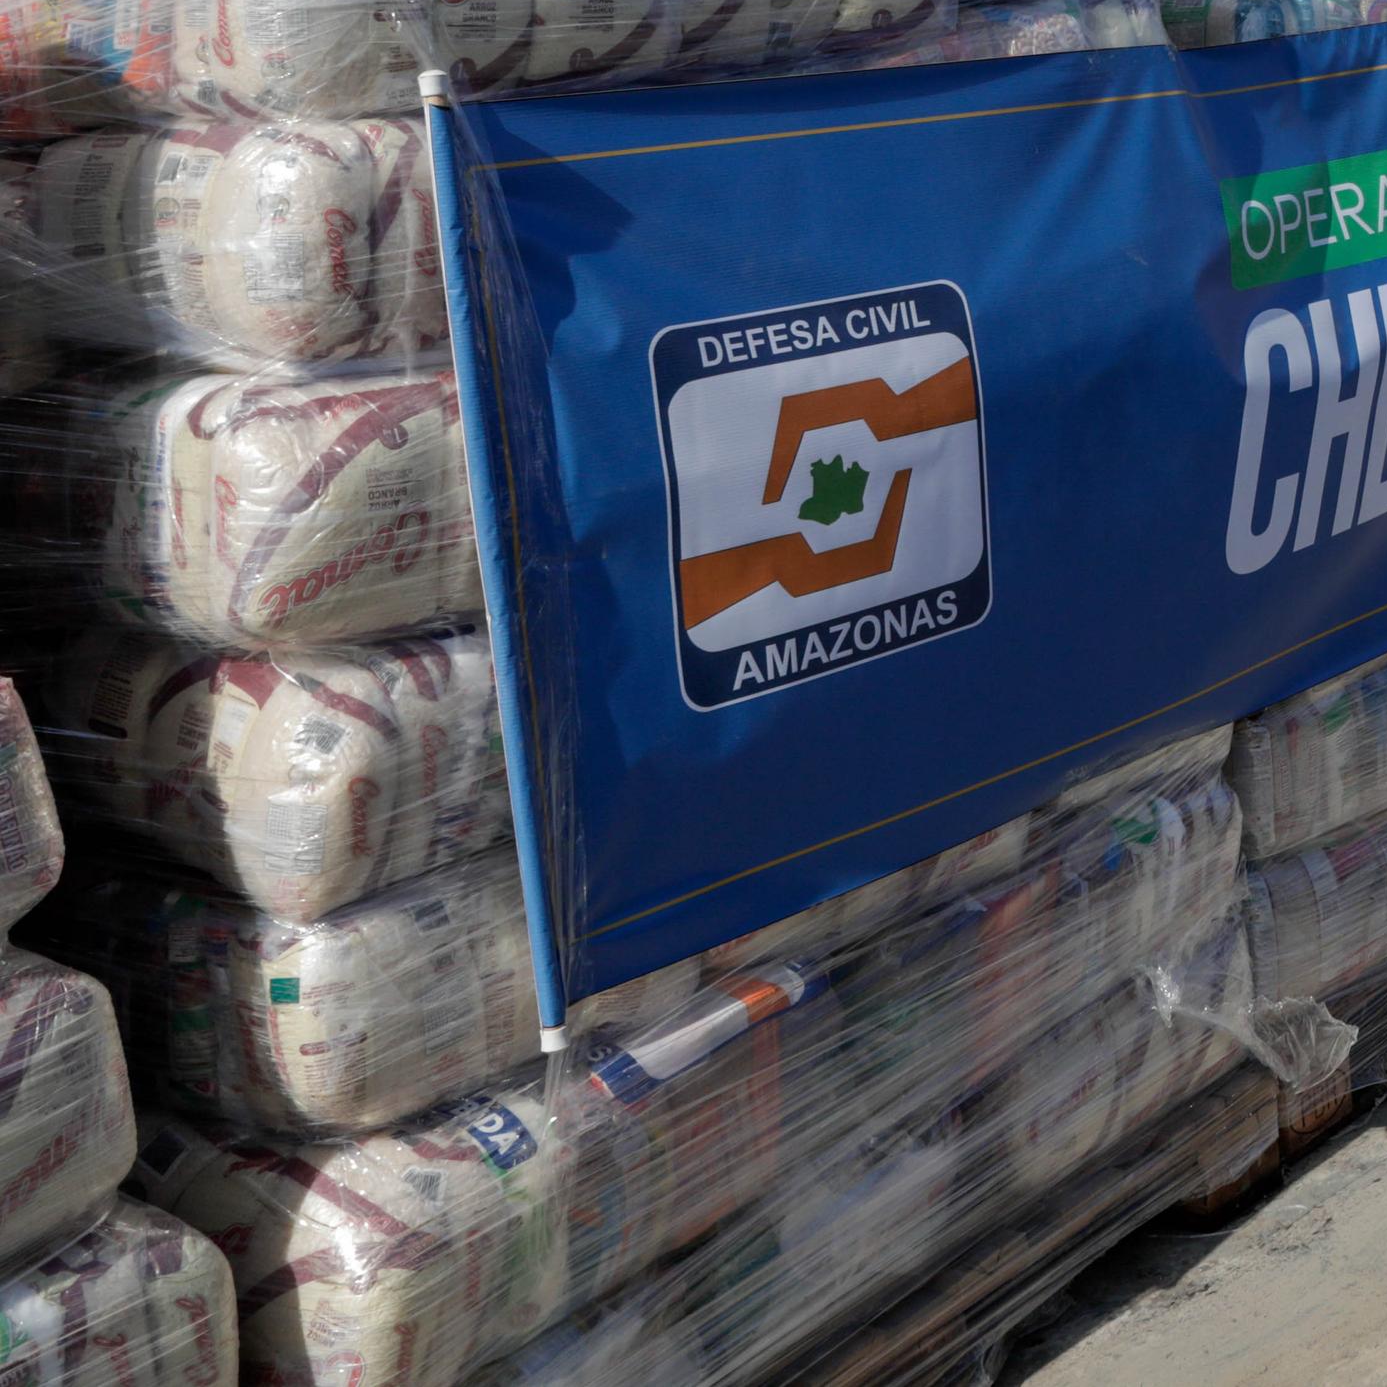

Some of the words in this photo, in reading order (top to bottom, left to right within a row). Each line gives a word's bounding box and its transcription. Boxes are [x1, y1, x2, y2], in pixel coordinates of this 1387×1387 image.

[697, 315, 841, 368] DEFESA
[845, 299, 932, 339] CIVIL
[732, 589, 959, 692] AMAZONAS
